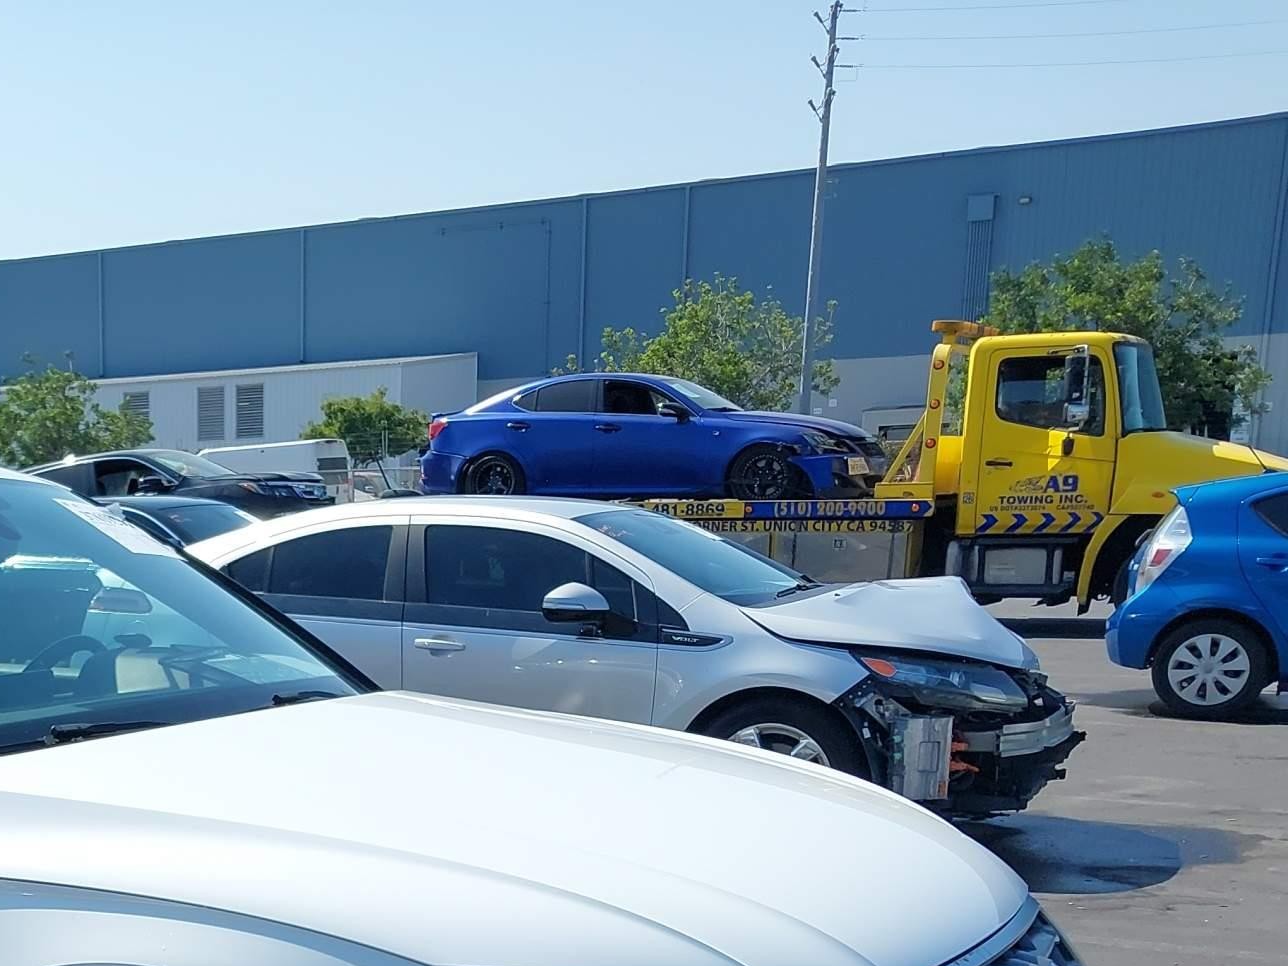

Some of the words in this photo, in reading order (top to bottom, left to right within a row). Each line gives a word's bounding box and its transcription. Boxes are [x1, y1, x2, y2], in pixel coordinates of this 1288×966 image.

[1043, 474, 1079, 493] A9
[998, 494, 1054, 505] TOWING
[1059, 494, 1088, 504] INC.
[774, 501, 812, 517] (510)
[816, 501, 886, 516] 200-9900
[740, 520, 759, 532] ST.
[764, 520, 808, 533] UNION
[812, 520, 844, 533] CITY
[846, 520, 866, 533] CA
[869, 520, 913, 533] 94587
[671, 635, 700, 643] VOLT
